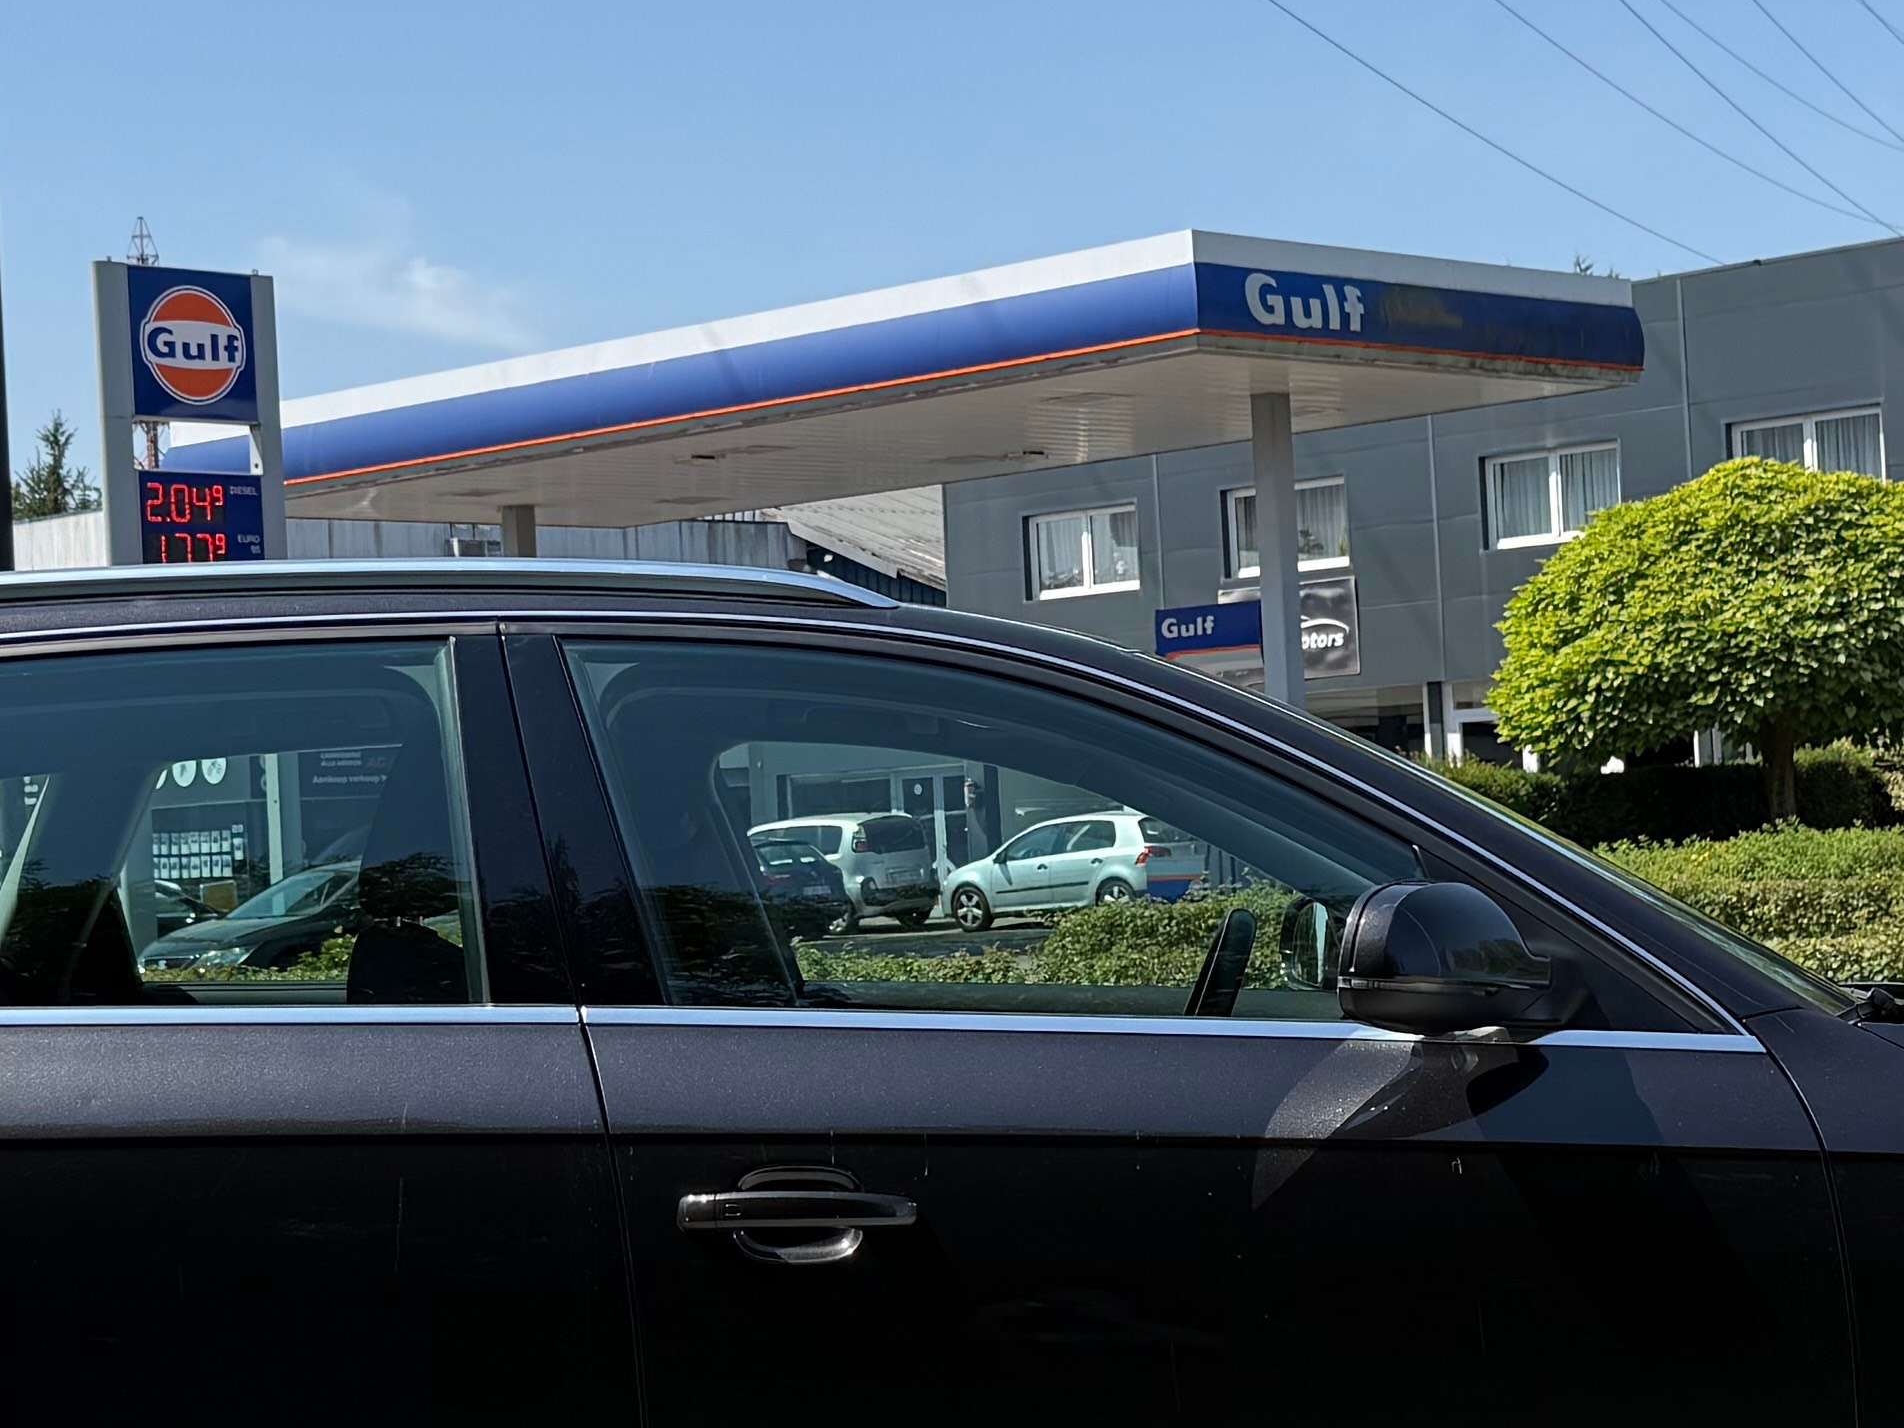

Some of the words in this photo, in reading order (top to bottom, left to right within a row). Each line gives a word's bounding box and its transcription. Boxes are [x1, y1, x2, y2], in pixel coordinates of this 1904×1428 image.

[1245, 273, 1365, 333] Gulf
[147, 326, 239, 364] Gulf
[1161, 615, 1215, 639] Gulf
[1301, 631, 1345, 650] otors
